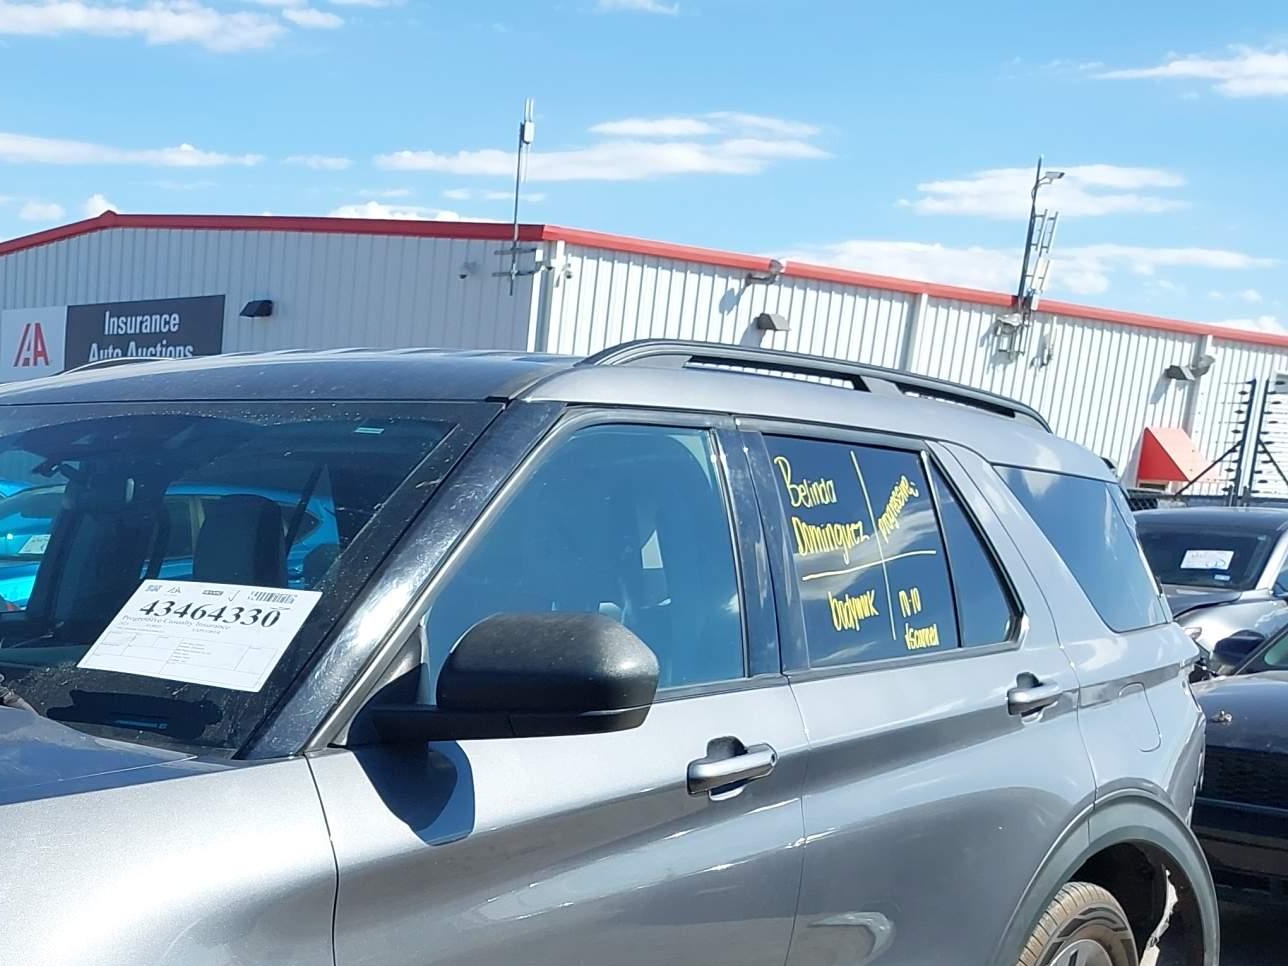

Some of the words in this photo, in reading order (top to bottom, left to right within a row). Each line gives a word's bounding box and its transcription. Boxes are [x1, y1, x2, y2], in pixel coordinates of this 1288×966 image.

[104, 310, 180, 336] Insurance
[774, 456, 837, 508] Belinda
[139, 600, 281, 628] 43464330
